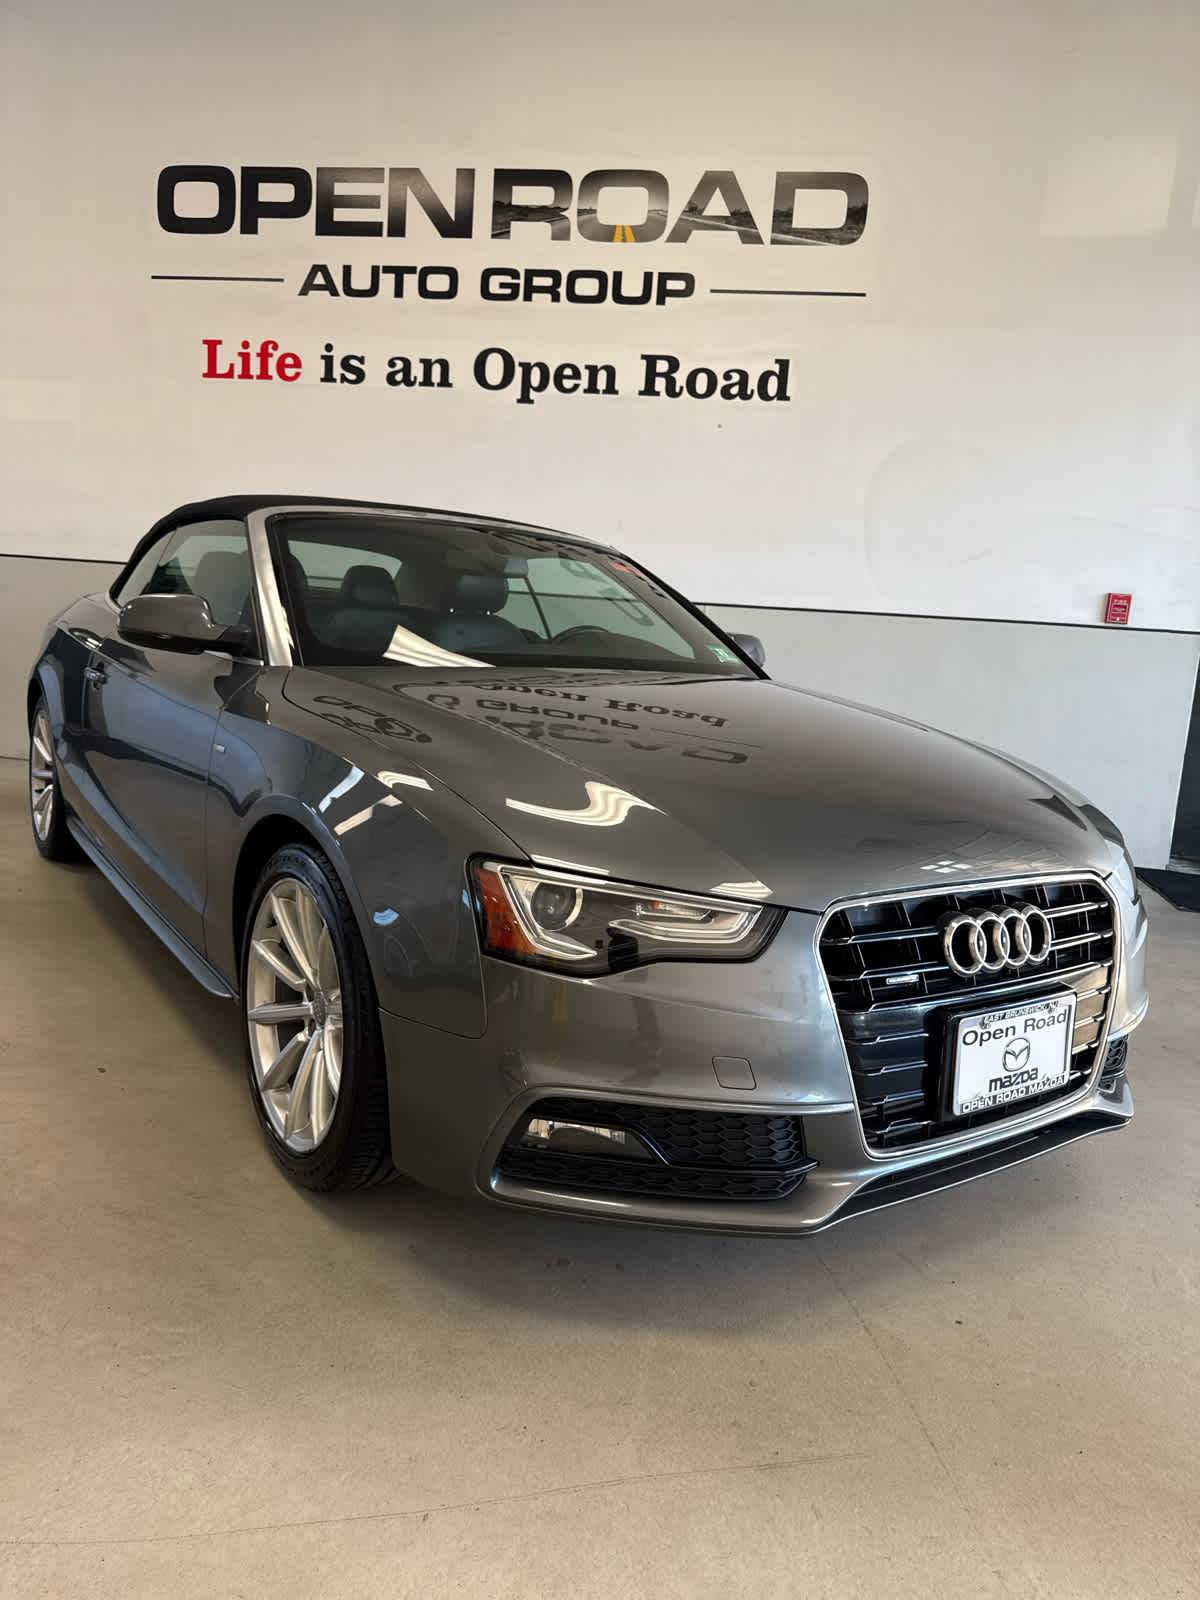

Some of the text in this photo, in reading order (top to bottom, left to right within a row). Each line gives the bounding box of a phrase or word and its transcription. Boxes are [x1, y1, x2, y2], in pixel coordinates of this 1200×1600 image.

[156, 164, 869, 246] OPEN ROAD
[298, 263, 696, 306] AUTO GROUP
[202, 339, 791, 405] Life is an Open Road
[962, 1008, 1067, 1046] Open Road
[962, 1074, 1066, 1113] OPEN ROAD MAZDA
